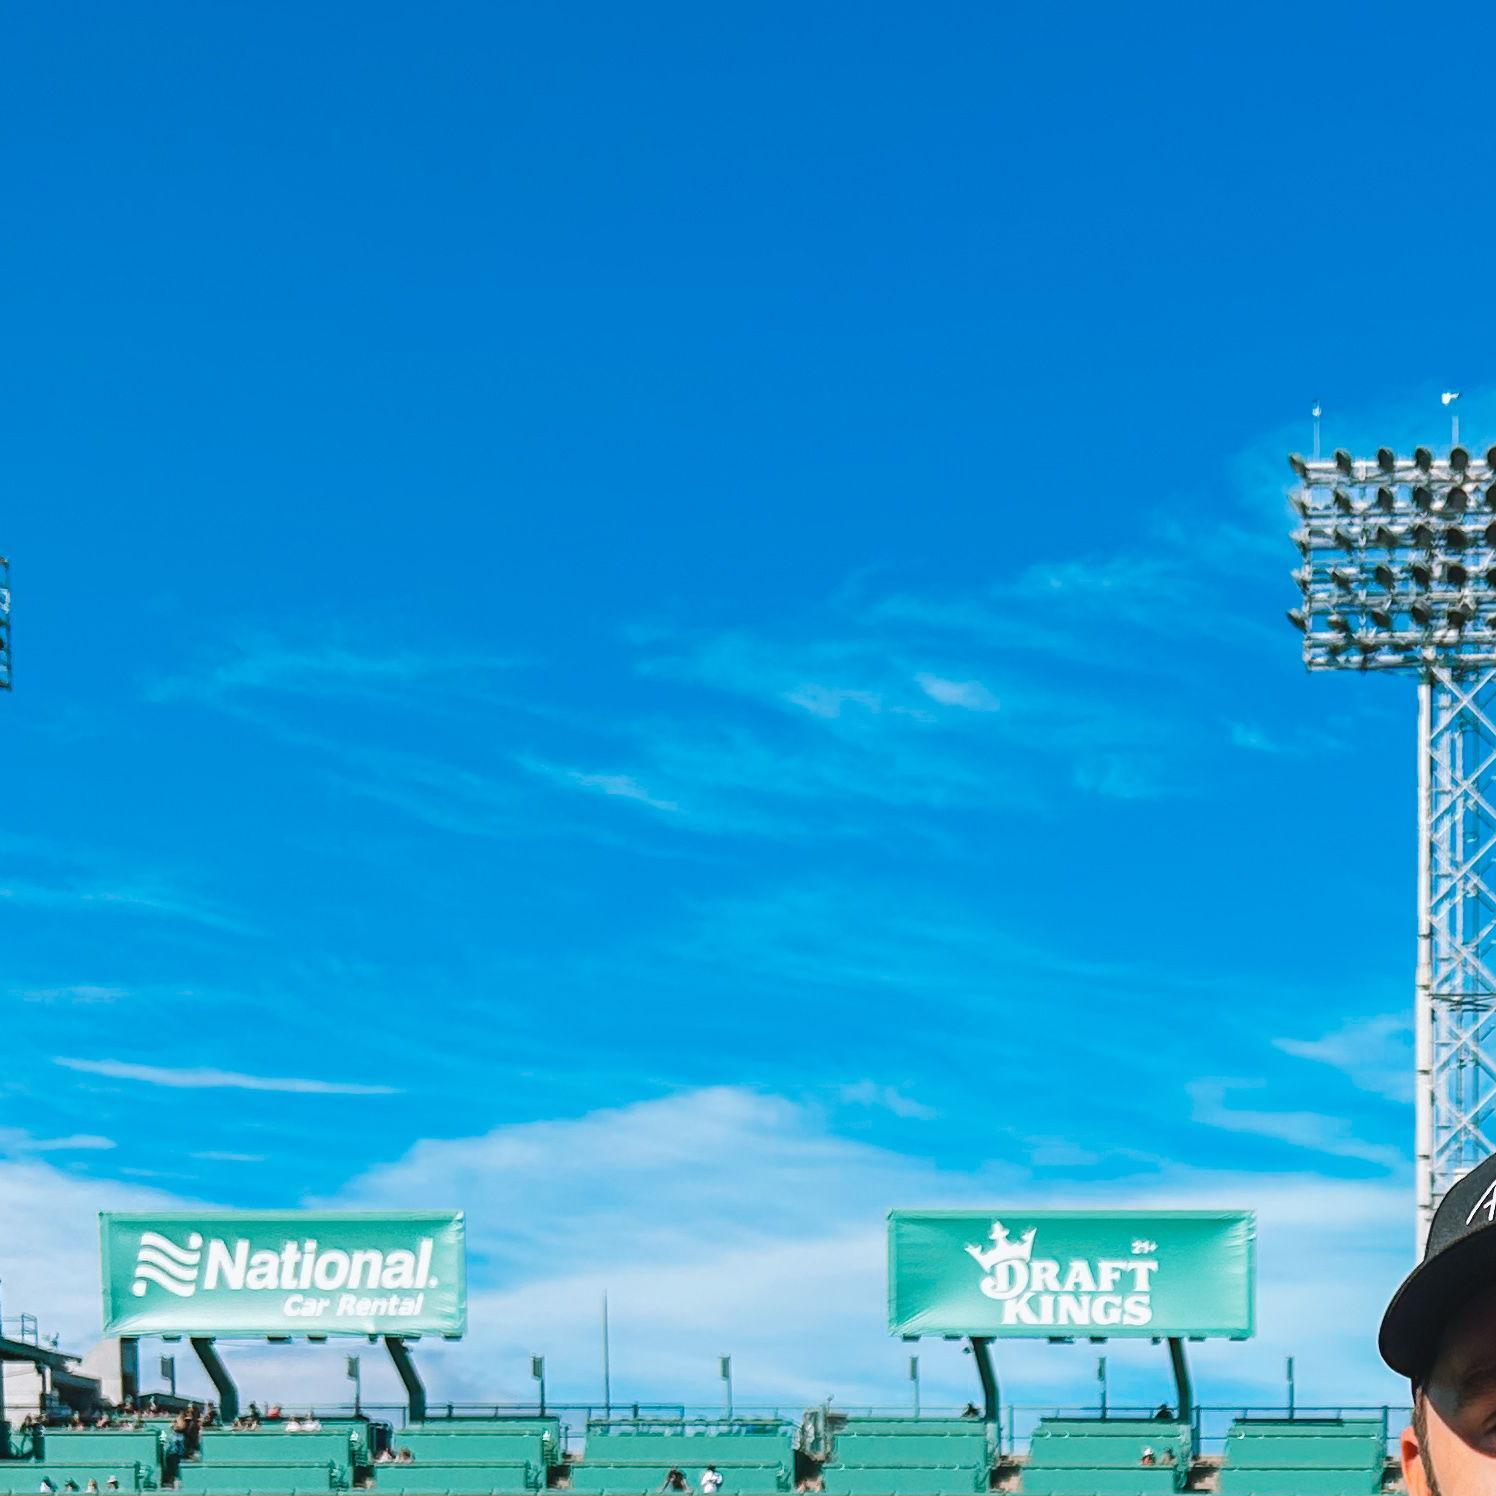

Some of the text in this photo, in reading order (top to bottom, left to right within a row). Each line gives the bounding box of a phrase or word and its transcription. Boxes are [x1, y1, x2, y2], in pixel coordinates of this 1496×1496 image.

[980, 1258, 1159, 1300] DRAFT
[282, 1292, 425, 1318] Car Rental
[1000, 1293, 1153, 1327] KINGS
